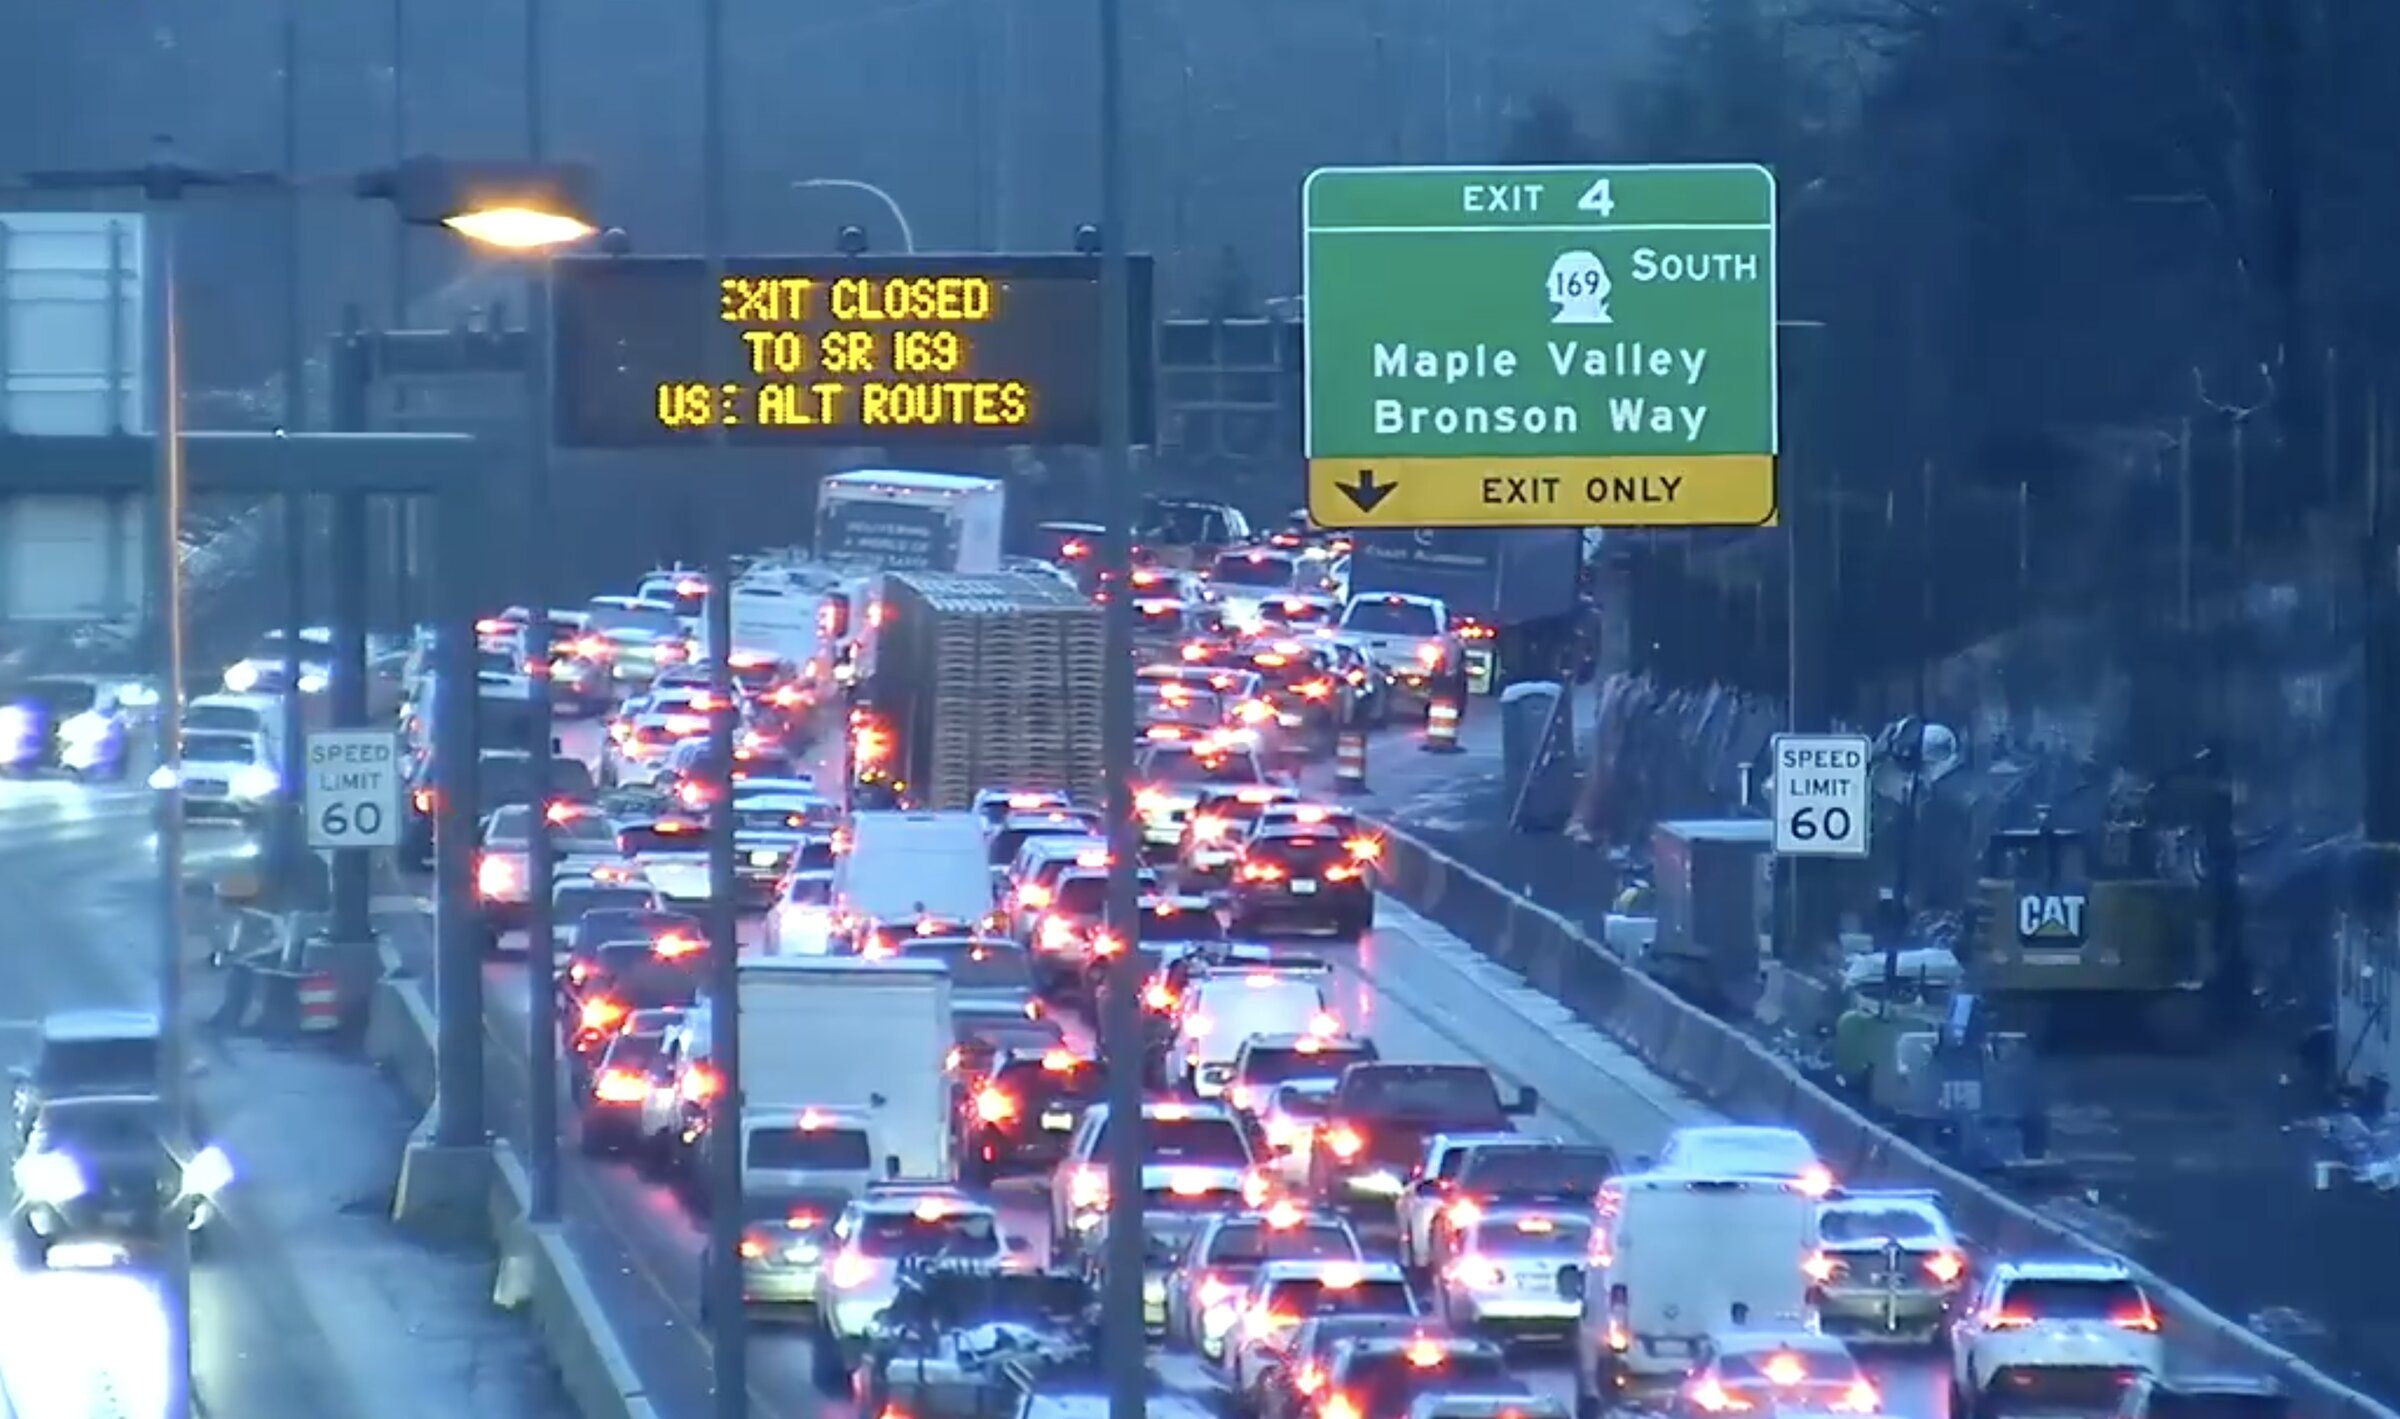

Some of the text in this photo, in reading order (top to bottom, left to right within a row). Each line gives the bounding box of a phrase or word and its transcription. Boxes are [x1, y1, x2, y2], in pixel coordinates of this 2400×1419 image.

[1463, 178, 1615, 217] EXIT 4
[830, 278, 992, 321] CLOSED
[1556, 270, 1601, 298] 169
[742, 331, 959, 373] TO SR 169
[1373, 341, 1707, 384] Maple Valley
[758, 383, 841, 424] ALT
[862, 383, 1026, 424] ROUTES
[1374, 397, 1707, 441] Bronson Way
[1482, 475, 1684, 505] EXIT ONLY
[311, 743, 391, 763] SPEED
[1783, 750, 1861, 768] SPEED
[320, 772, 381, 792] LIMIT
[1790, 778, 1851, 796] LIMIT
[321, 801, 382, 836] 60
[1790, 806, 1851, 841] 60
[2020, 895, 2085, 937] CAT
